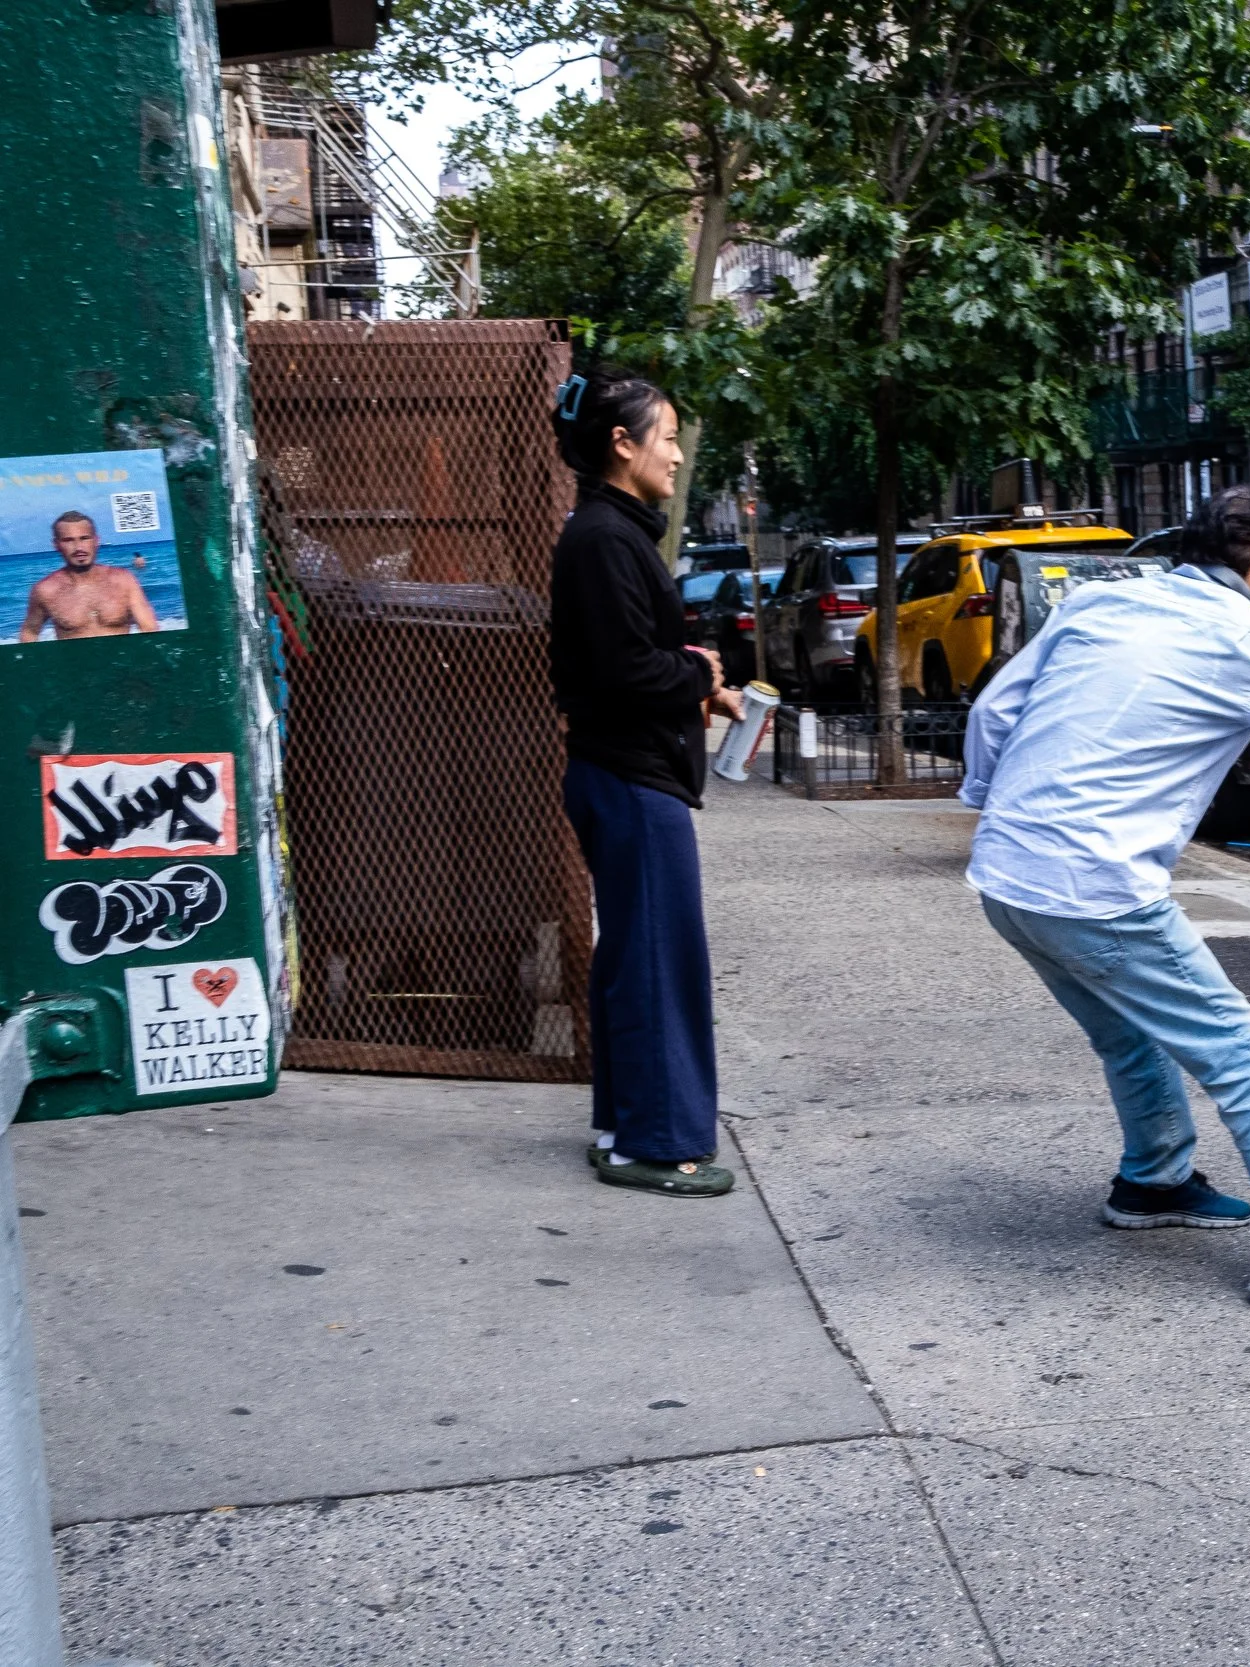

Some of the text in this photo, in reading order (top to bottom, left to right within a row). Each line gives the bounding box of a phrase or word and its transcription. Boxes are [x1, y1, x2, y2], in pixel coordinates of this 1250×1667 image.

[152, 973, 179, 1012] I
[143, 1013, 259, 1050] KELLY
[140, 1048, 267, 1085] WALKER
